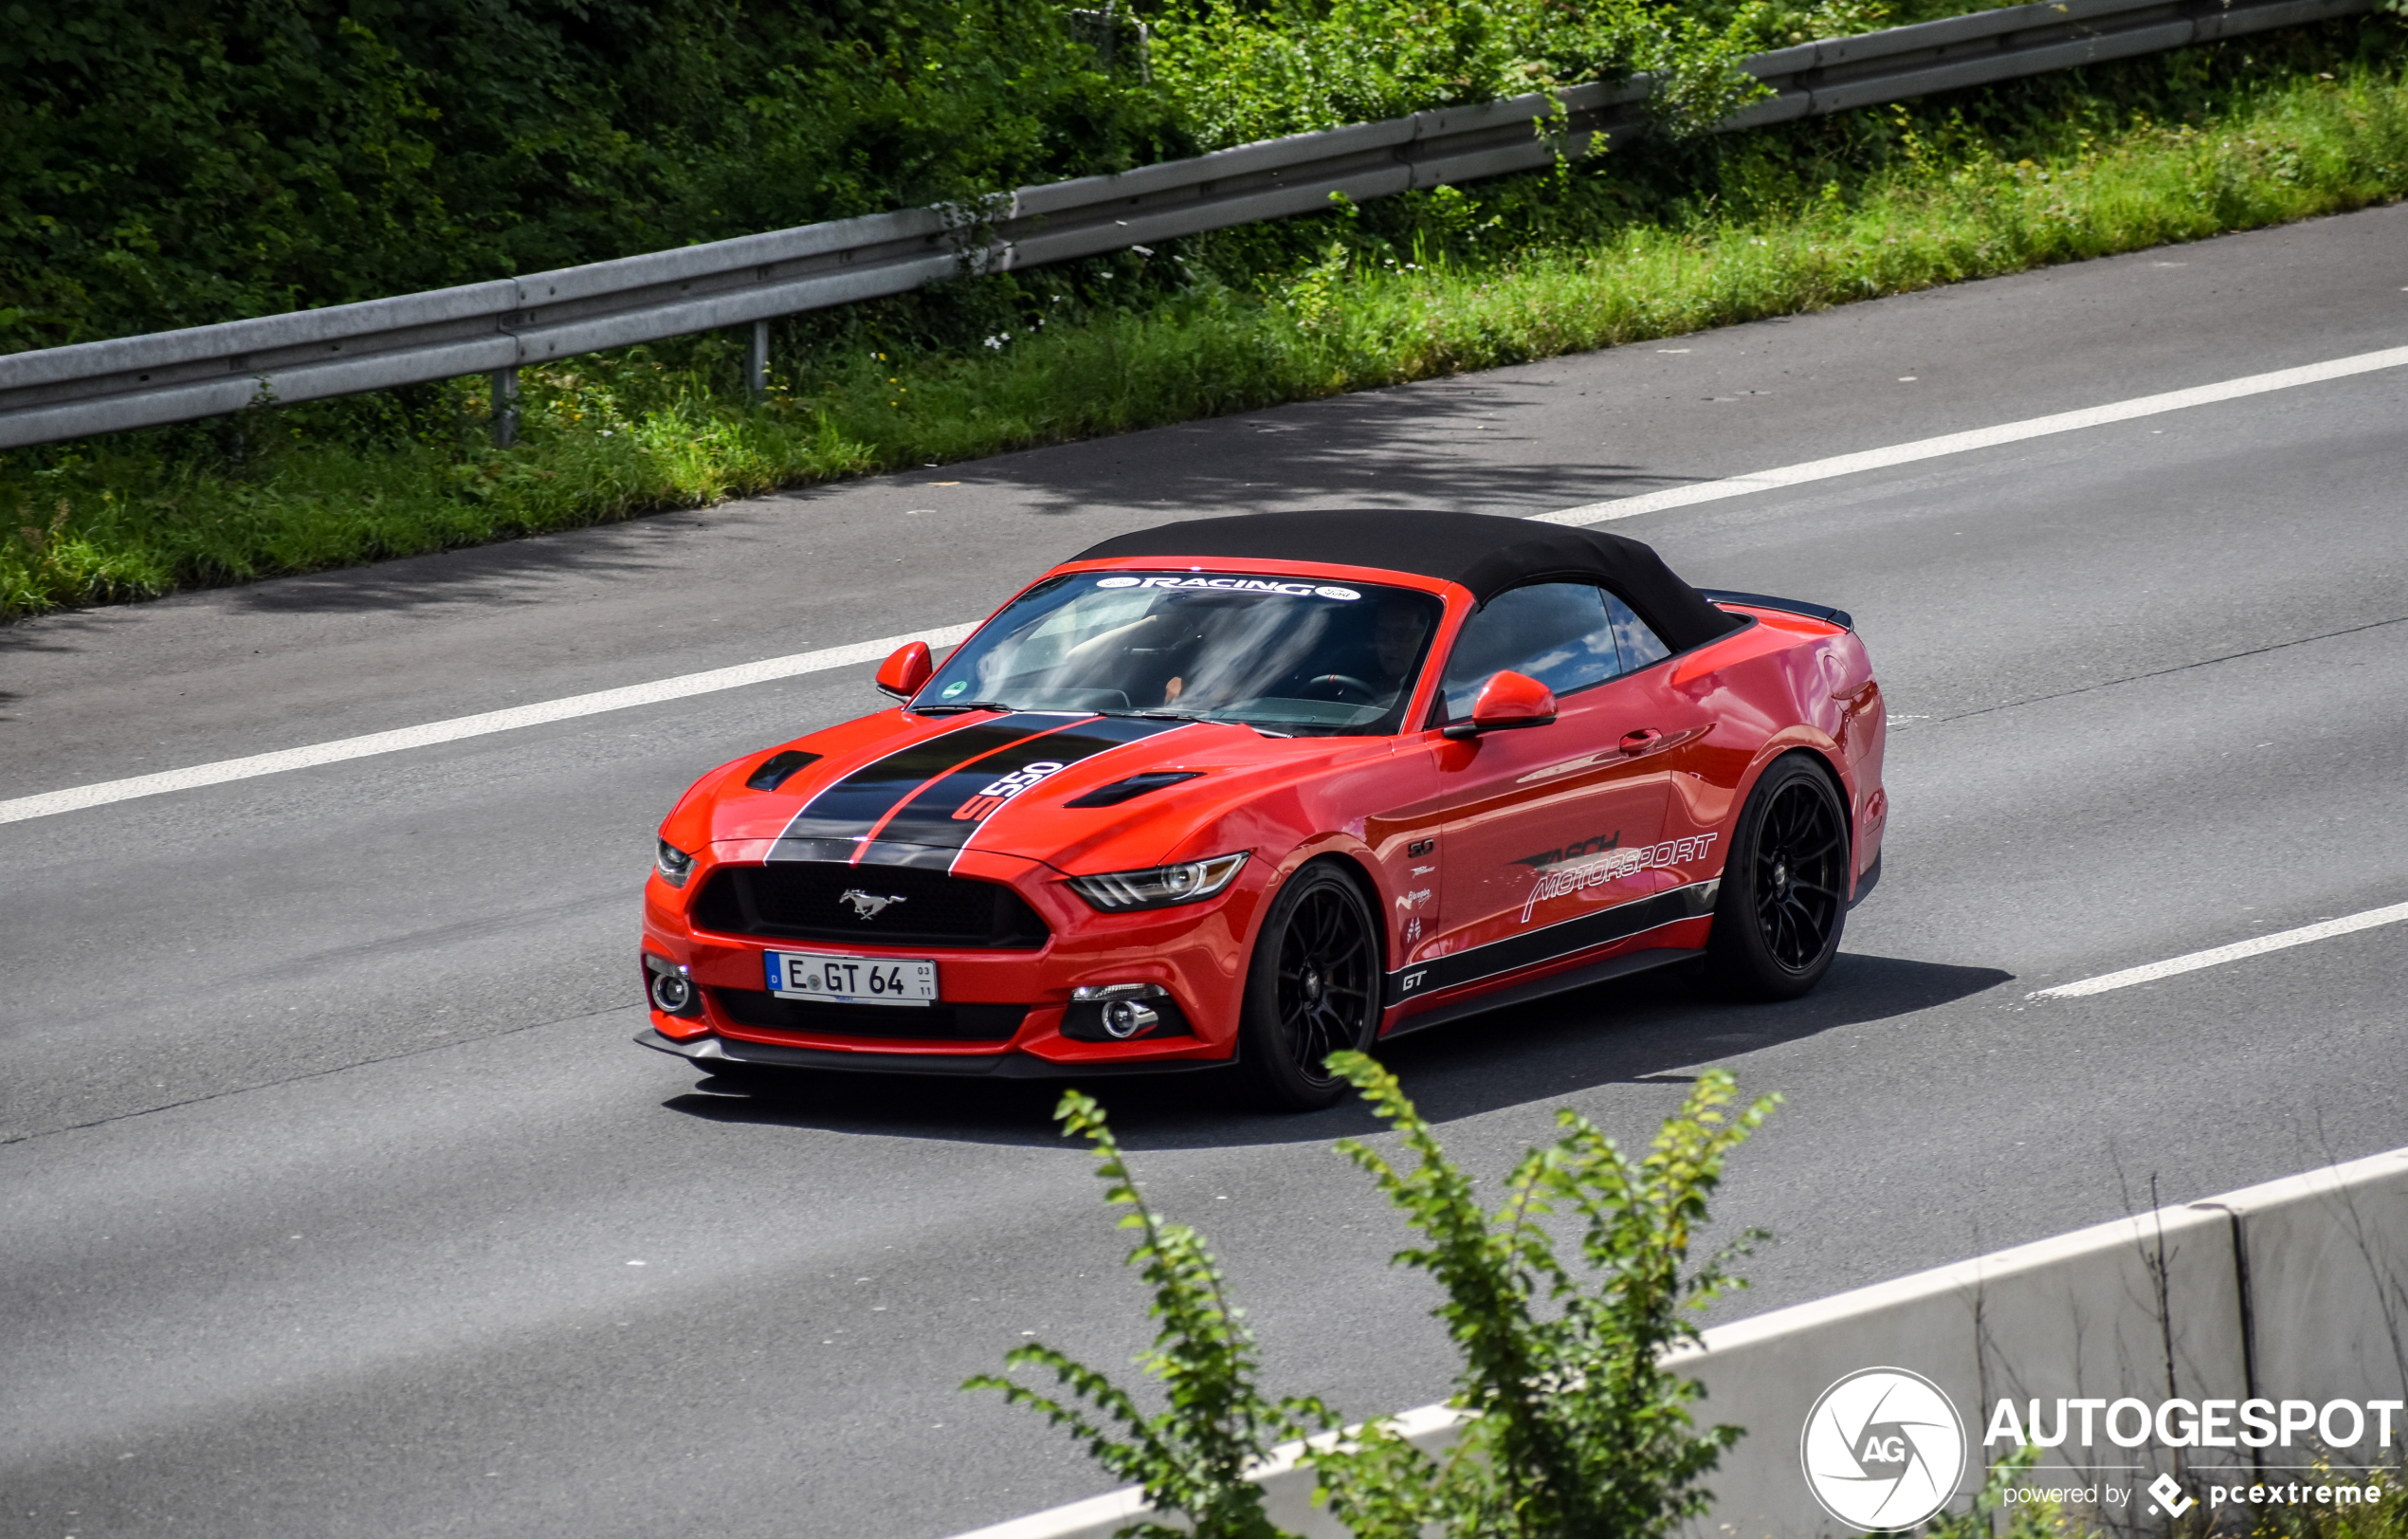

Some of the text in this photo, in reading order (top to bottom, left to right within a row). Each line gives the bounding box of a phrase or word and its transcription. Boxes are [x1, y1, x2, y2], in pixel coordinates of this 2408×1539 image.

[1140, 577, 1316, 596] RACING
[1521, 832, 1718, 924] MOTORSPORT
[771, 960, 904, 995] D E GT 64
[918, 967, 930, 976] 03
[1403, 970, 1428, 991] GT
[920, 987, 931, 996] 11
